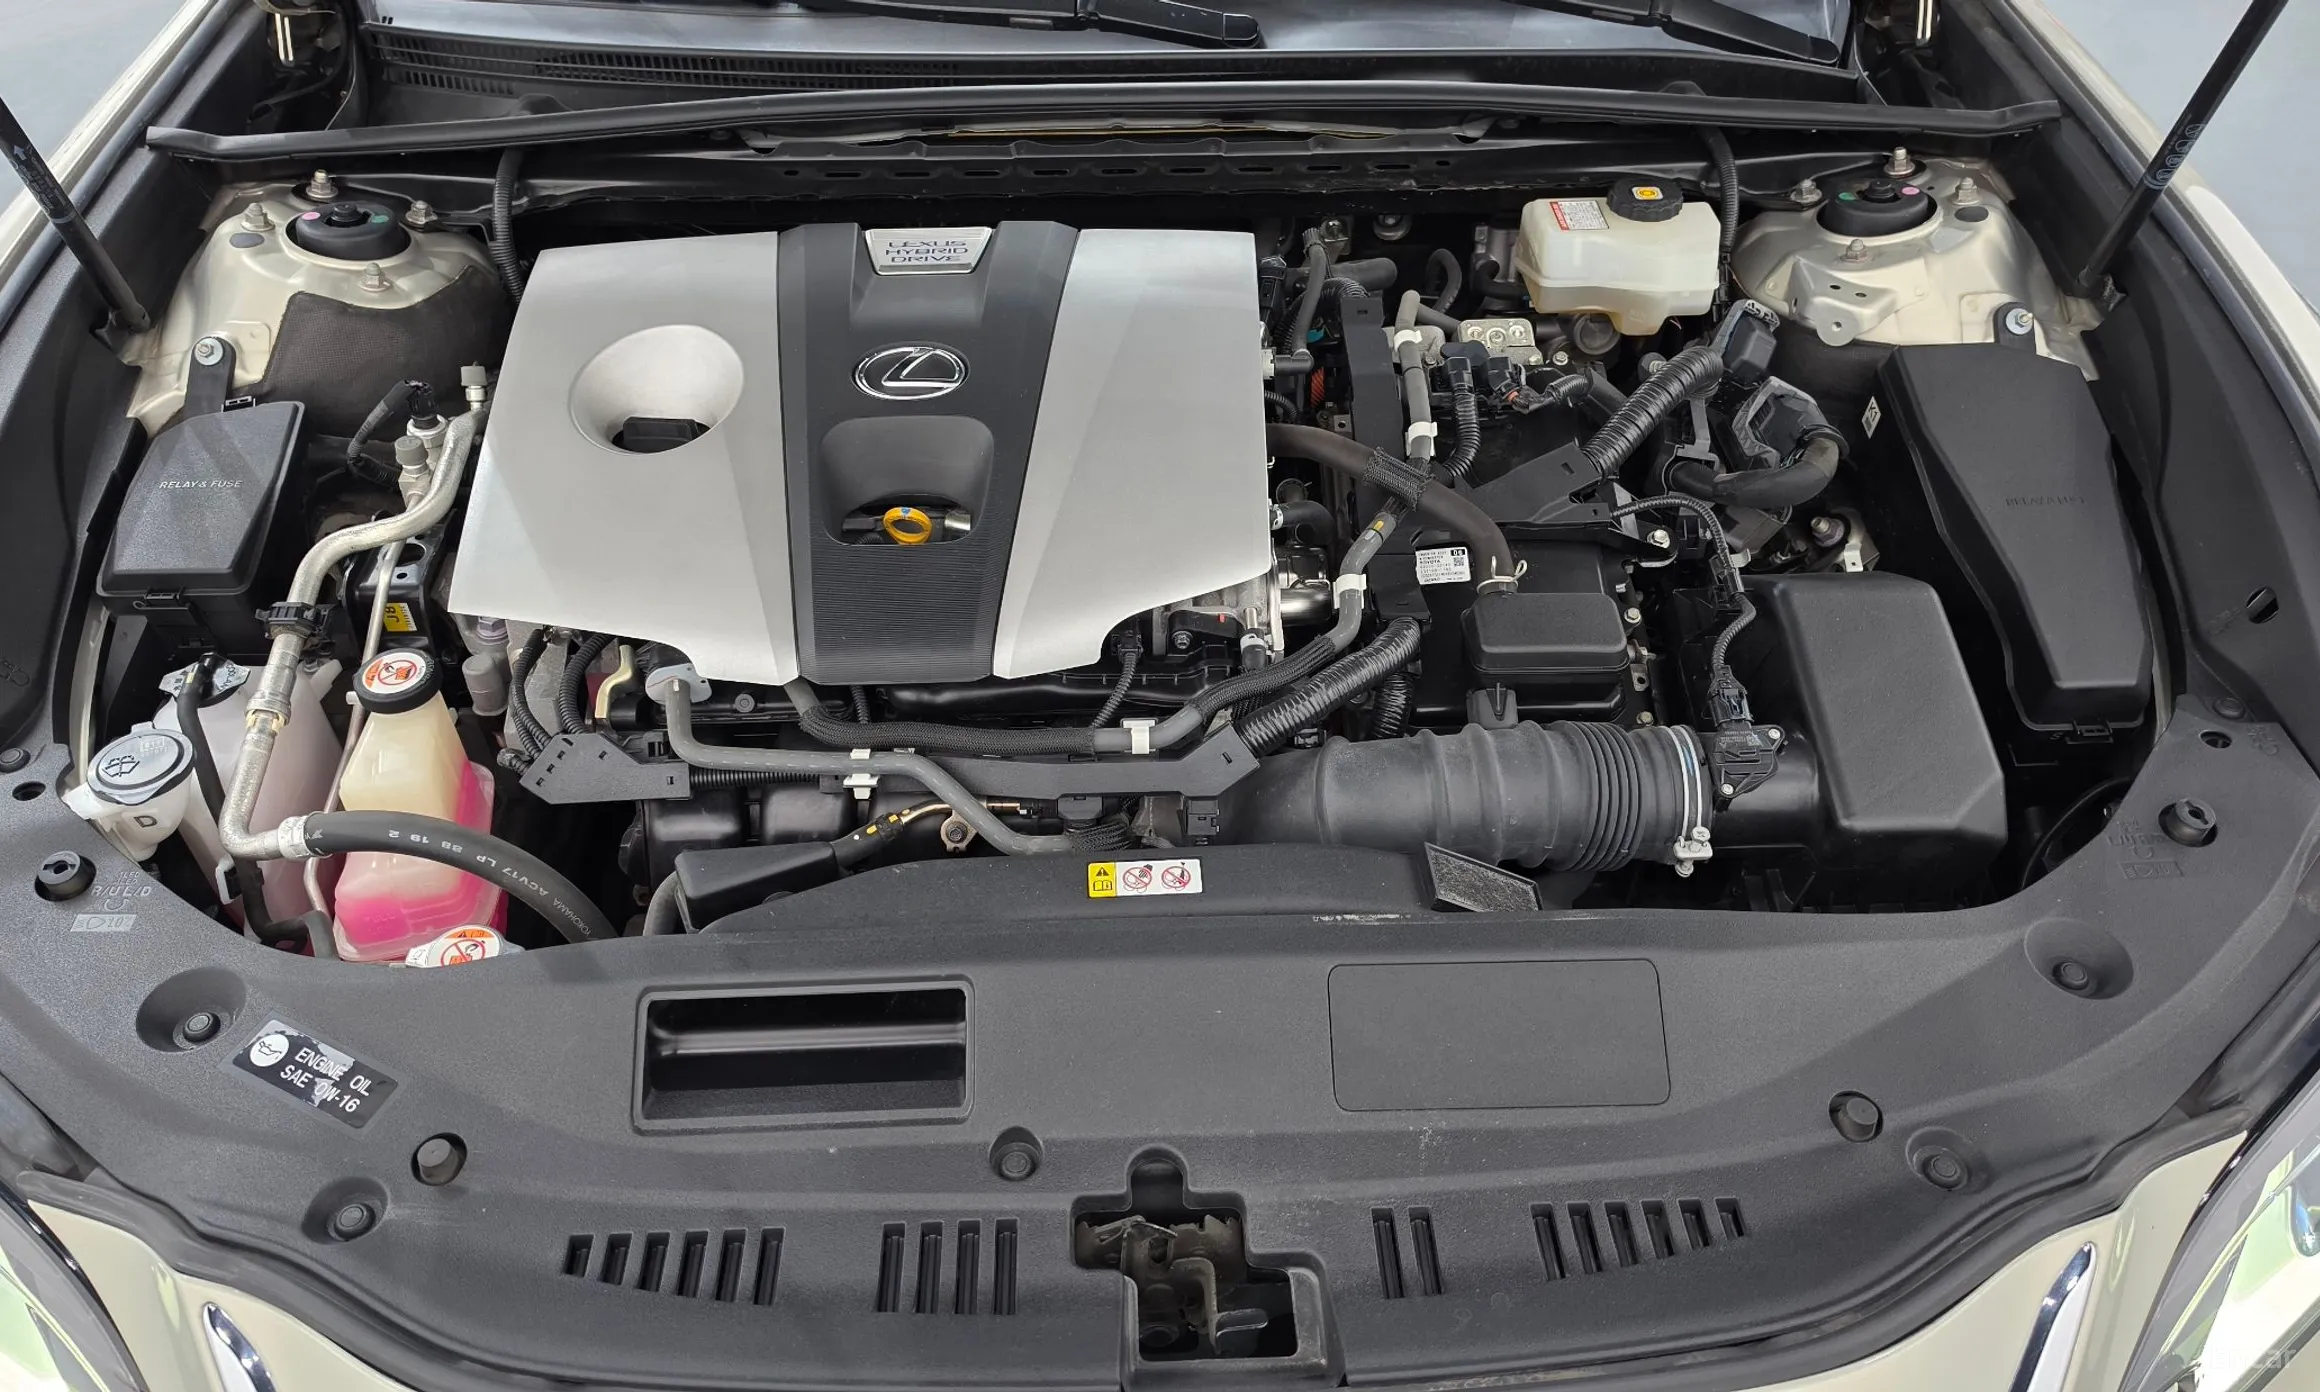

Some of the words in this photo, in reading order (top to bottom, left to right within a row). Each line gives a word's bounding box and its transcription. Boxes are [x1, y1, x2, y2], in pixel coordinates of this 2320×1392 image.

[889, 240, 967, 248] LEXUS
[885, 247, 969, 255] HYBRID
[210, 479, 243, 488] FUSE
[134, 815, 157, 828] D
[476, 855, 497, 868] LP
[501, 867, 549, 896] ACV17
[552, 897, 592, 936] YOKOHAMA
[294, 1047, 347, 1081] ENGINE
[349, 1074, 372, 1097] OIL
[280, 1064, 314, 1089] SAE
[314, 1081, 361, 1113] 0W-16
